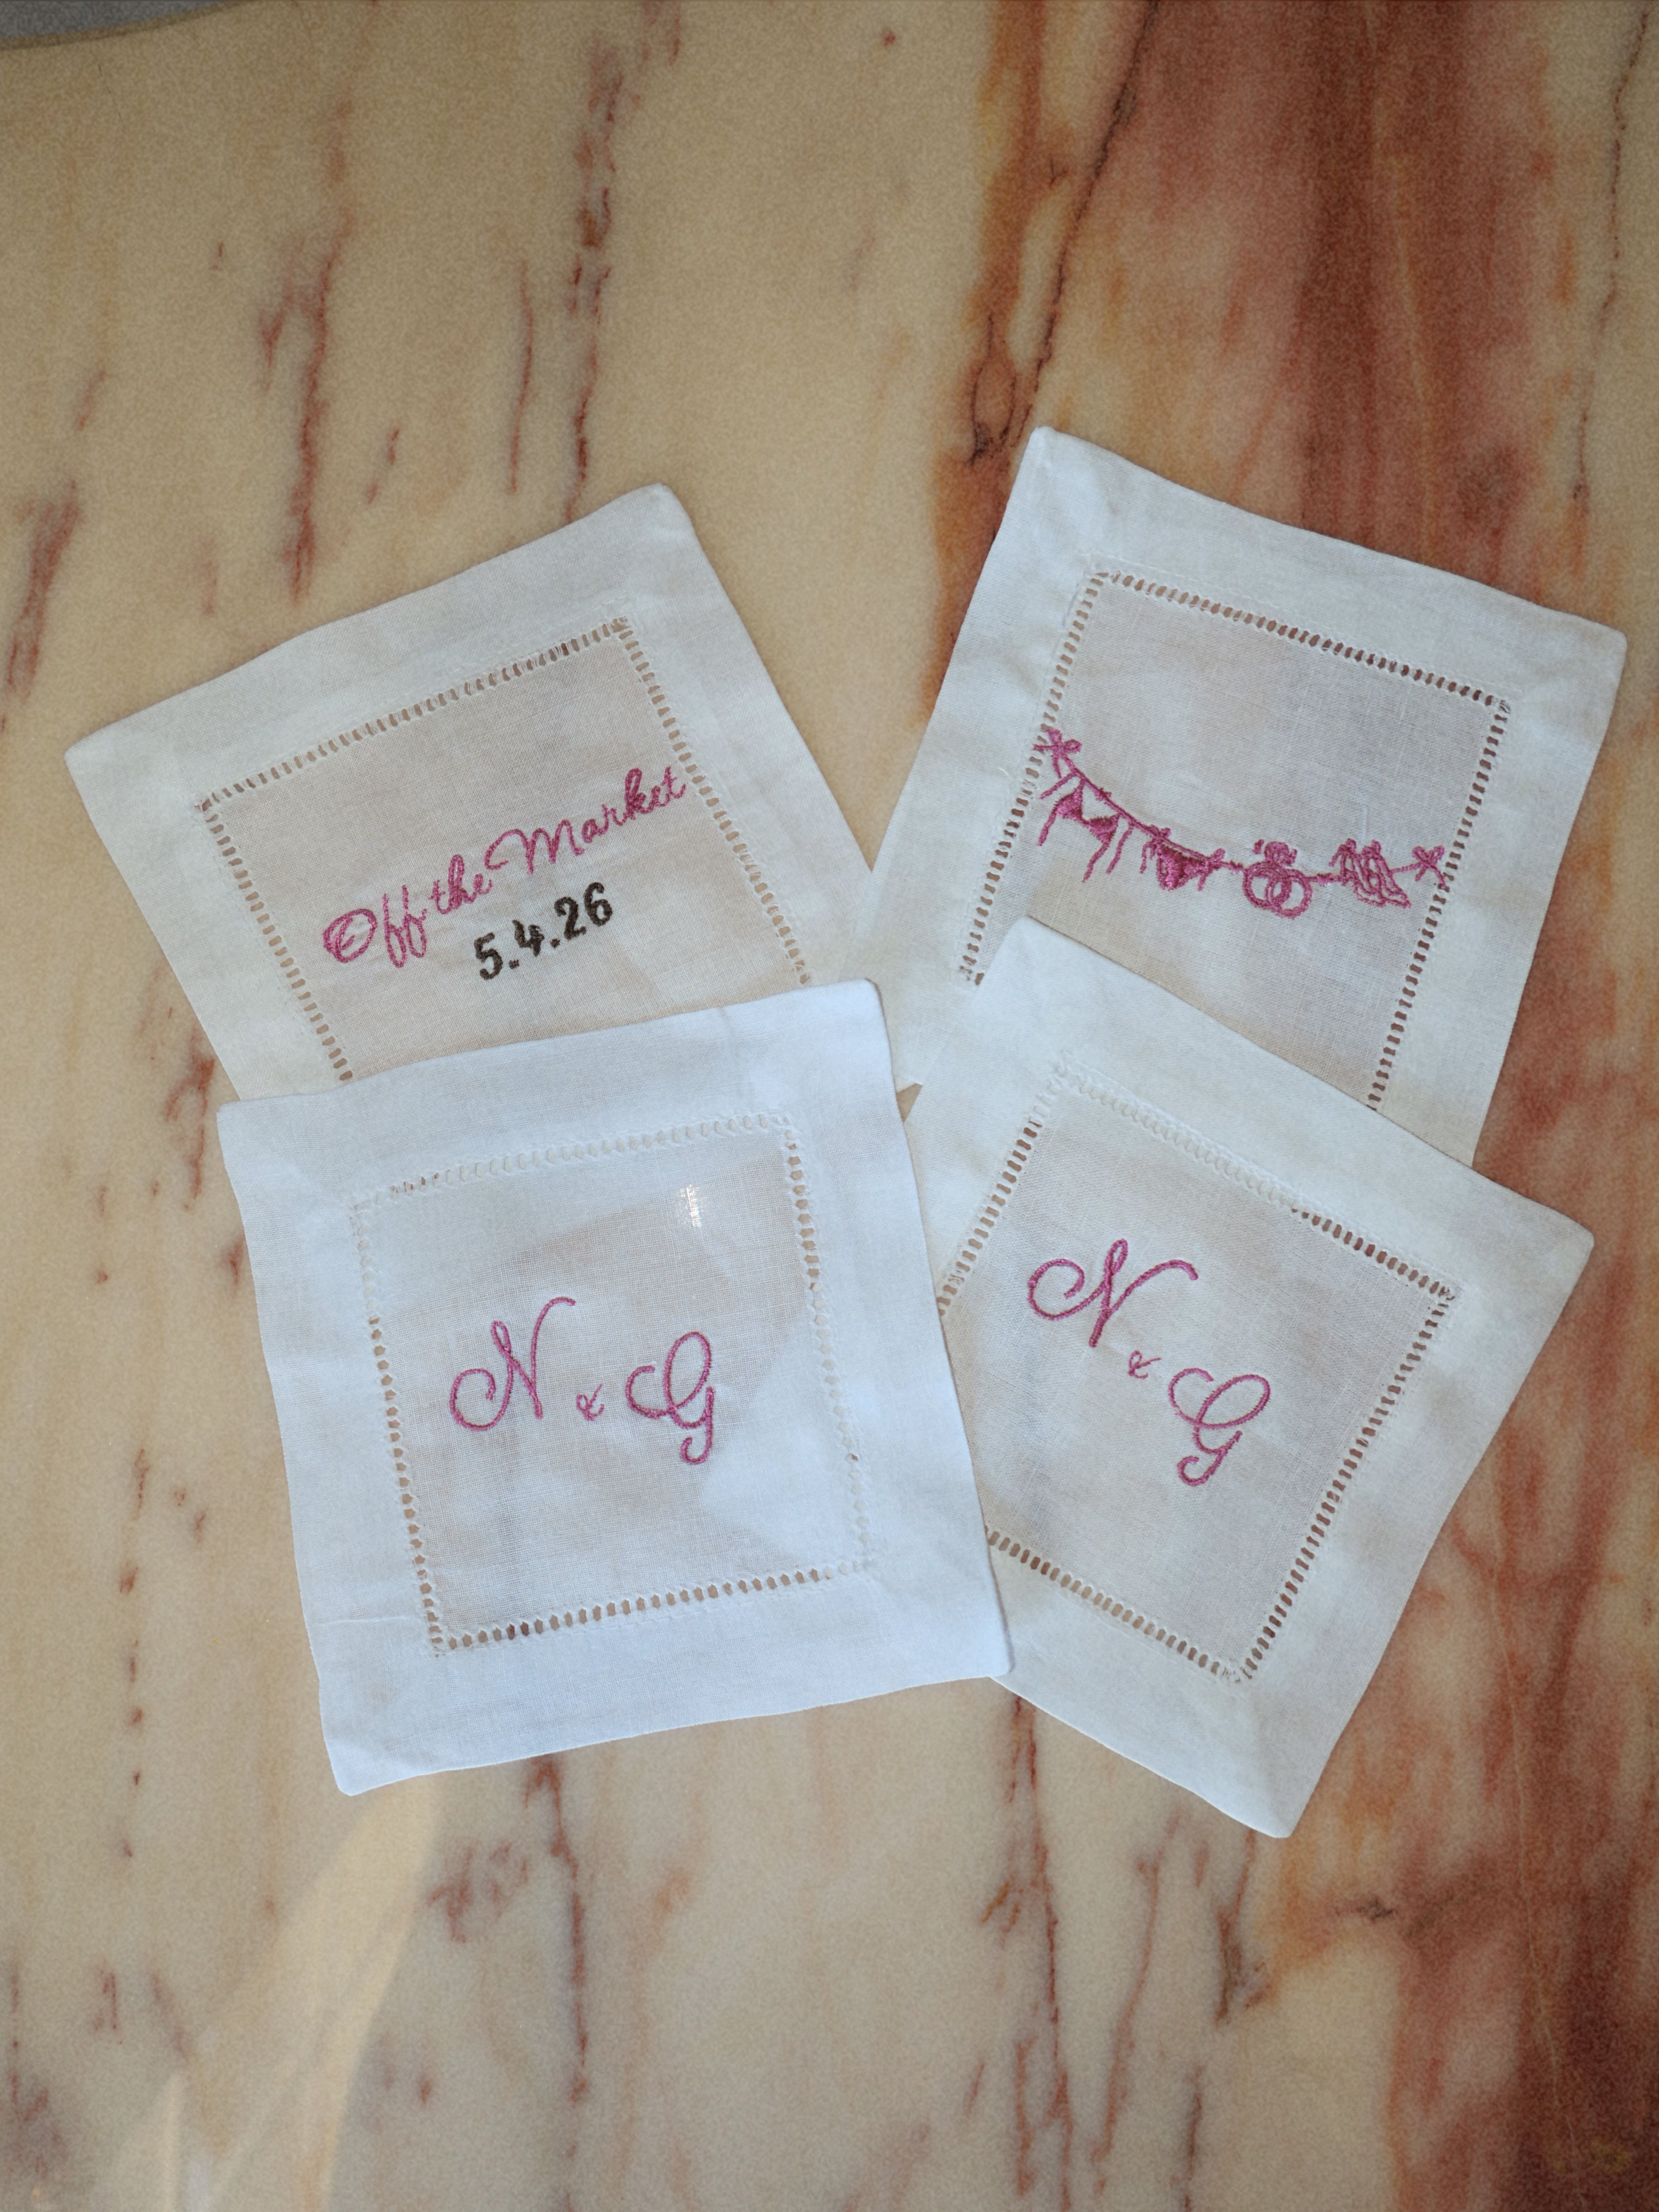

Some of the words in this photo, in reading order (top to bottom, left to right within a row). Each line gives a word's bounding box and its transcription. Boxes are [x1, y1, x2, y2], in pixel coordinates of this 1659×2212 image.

[323, 885, 429, 968] Off
[430, 854, 493, 915] the
[483, 766, 687, 874] Market
[473, 882, 613, 980] 5.4.26
[449, 1296, 576, 1431] N
[576, 1383, 604, 1421] &
[625, 1331, 715, 1465] G
[1027, 1238, 1199, 1348] N
[1127, 1350, 1162, 1379] &
[1168, 1367, 1271, 1487] G
